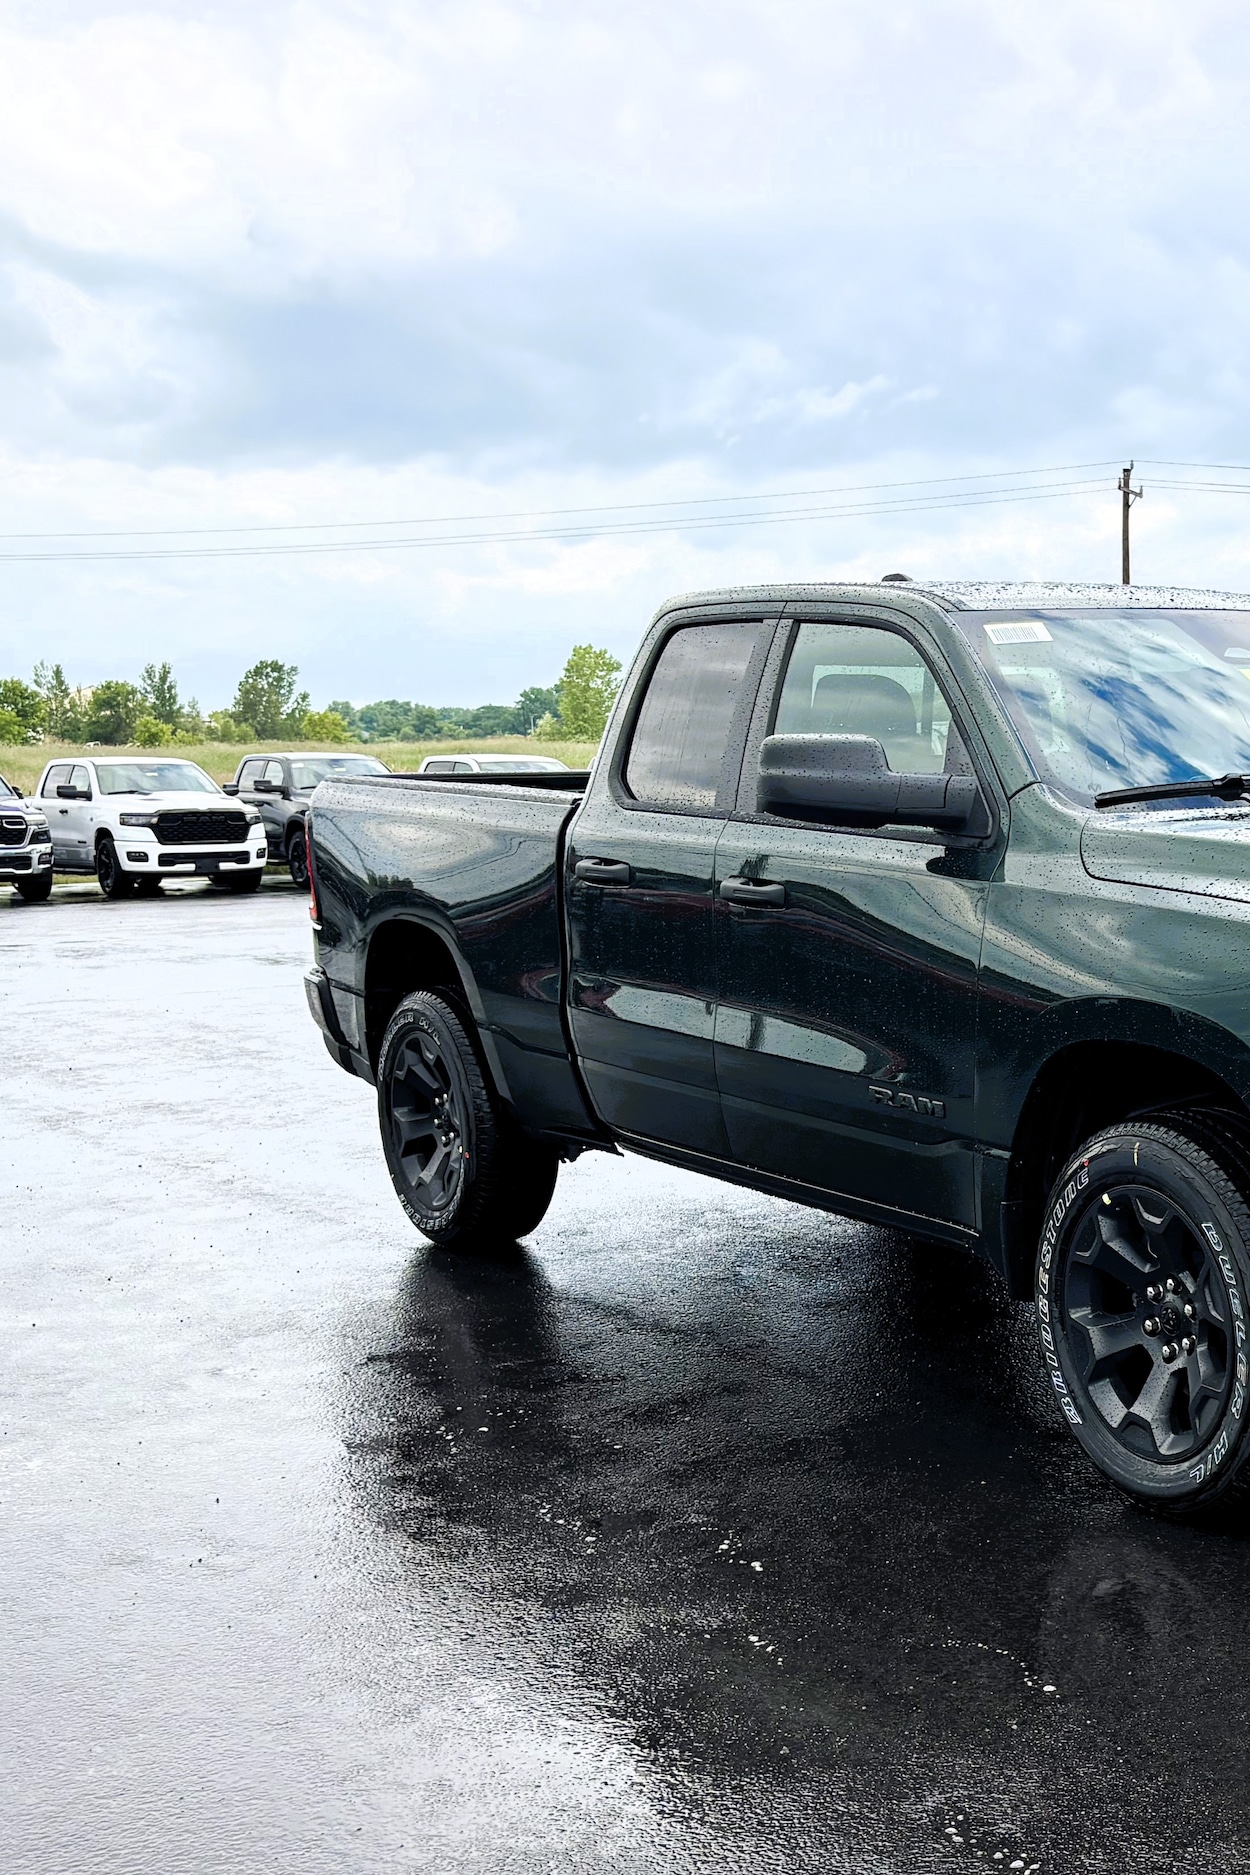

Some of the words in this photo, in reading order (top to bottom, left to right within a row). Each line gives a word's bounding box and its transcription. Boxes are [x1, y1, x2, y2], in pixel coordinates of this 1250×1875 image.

[868, 1085, 945, 1118] RAM
[1039, 1168, 1090, 1425] BRIDGESTONE
[1201, 1223, 1247, 1419] DUELER
